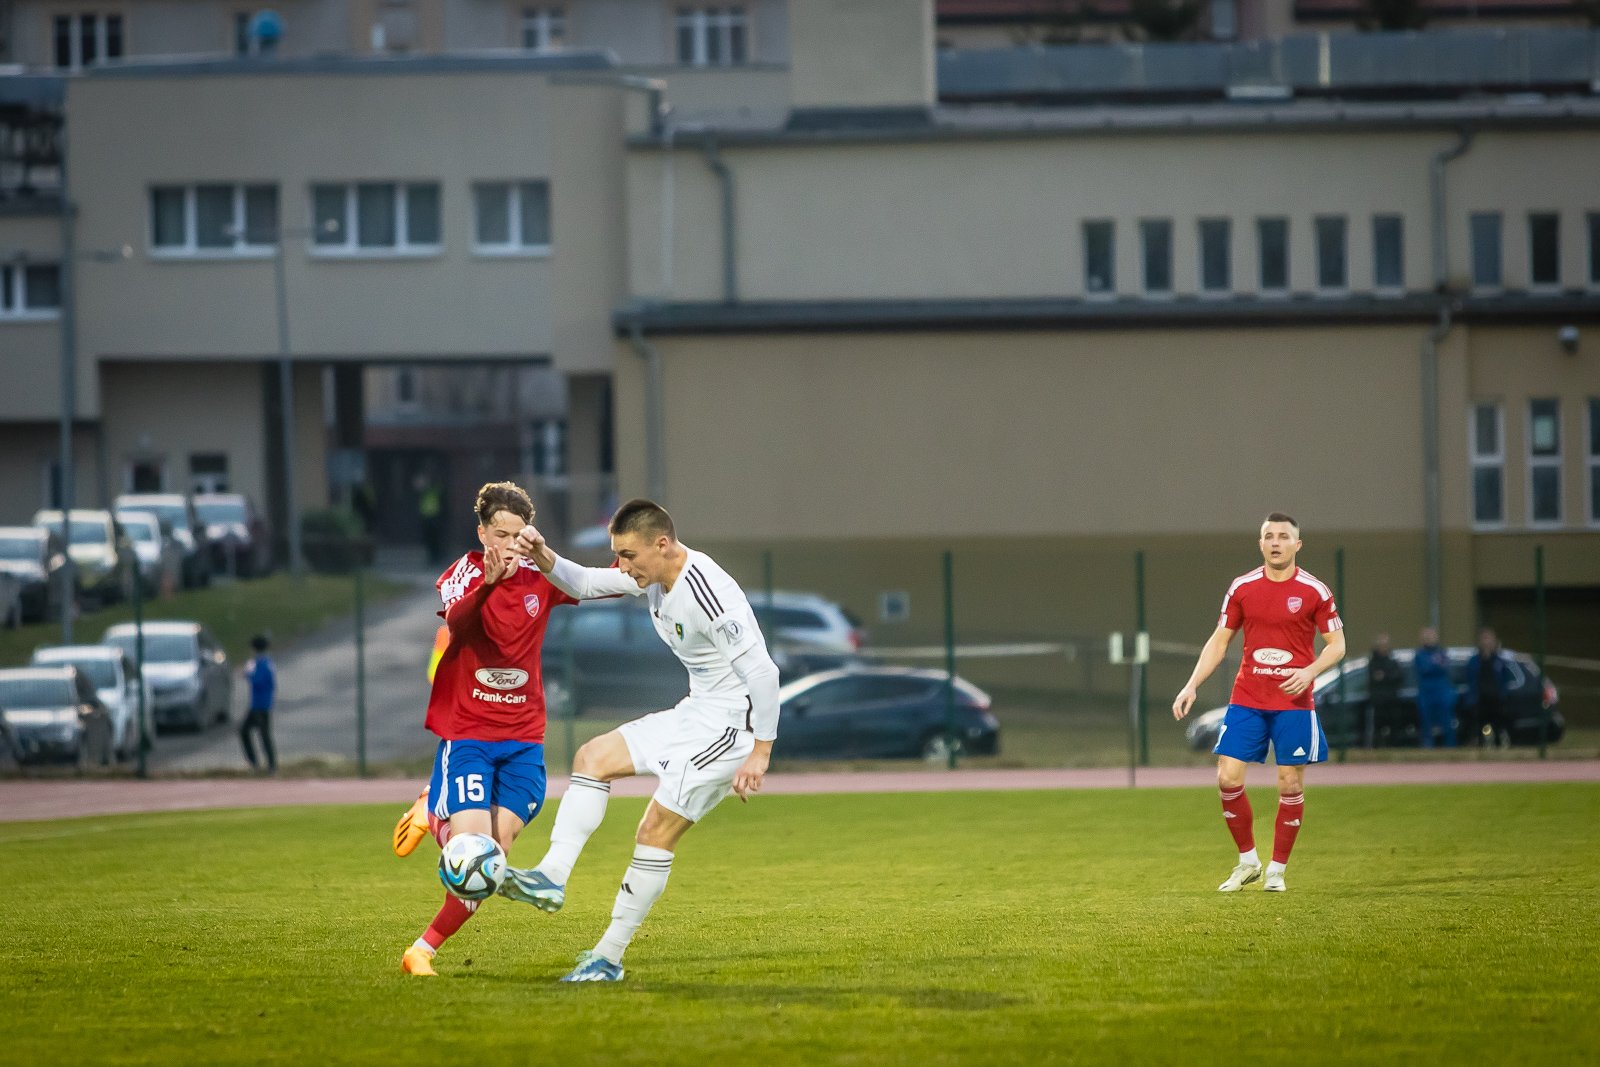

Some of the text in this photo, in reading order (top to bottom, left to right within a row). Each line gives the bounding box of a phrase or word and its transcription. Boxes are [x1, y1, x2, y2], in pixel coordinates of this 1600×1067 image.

[1261, 651, 1284, 662] Ford
[487, 671, 520, 685] Ford
[472, 688, 527, 704] Frank-Cars
[455, 773, 485, 803] 15
